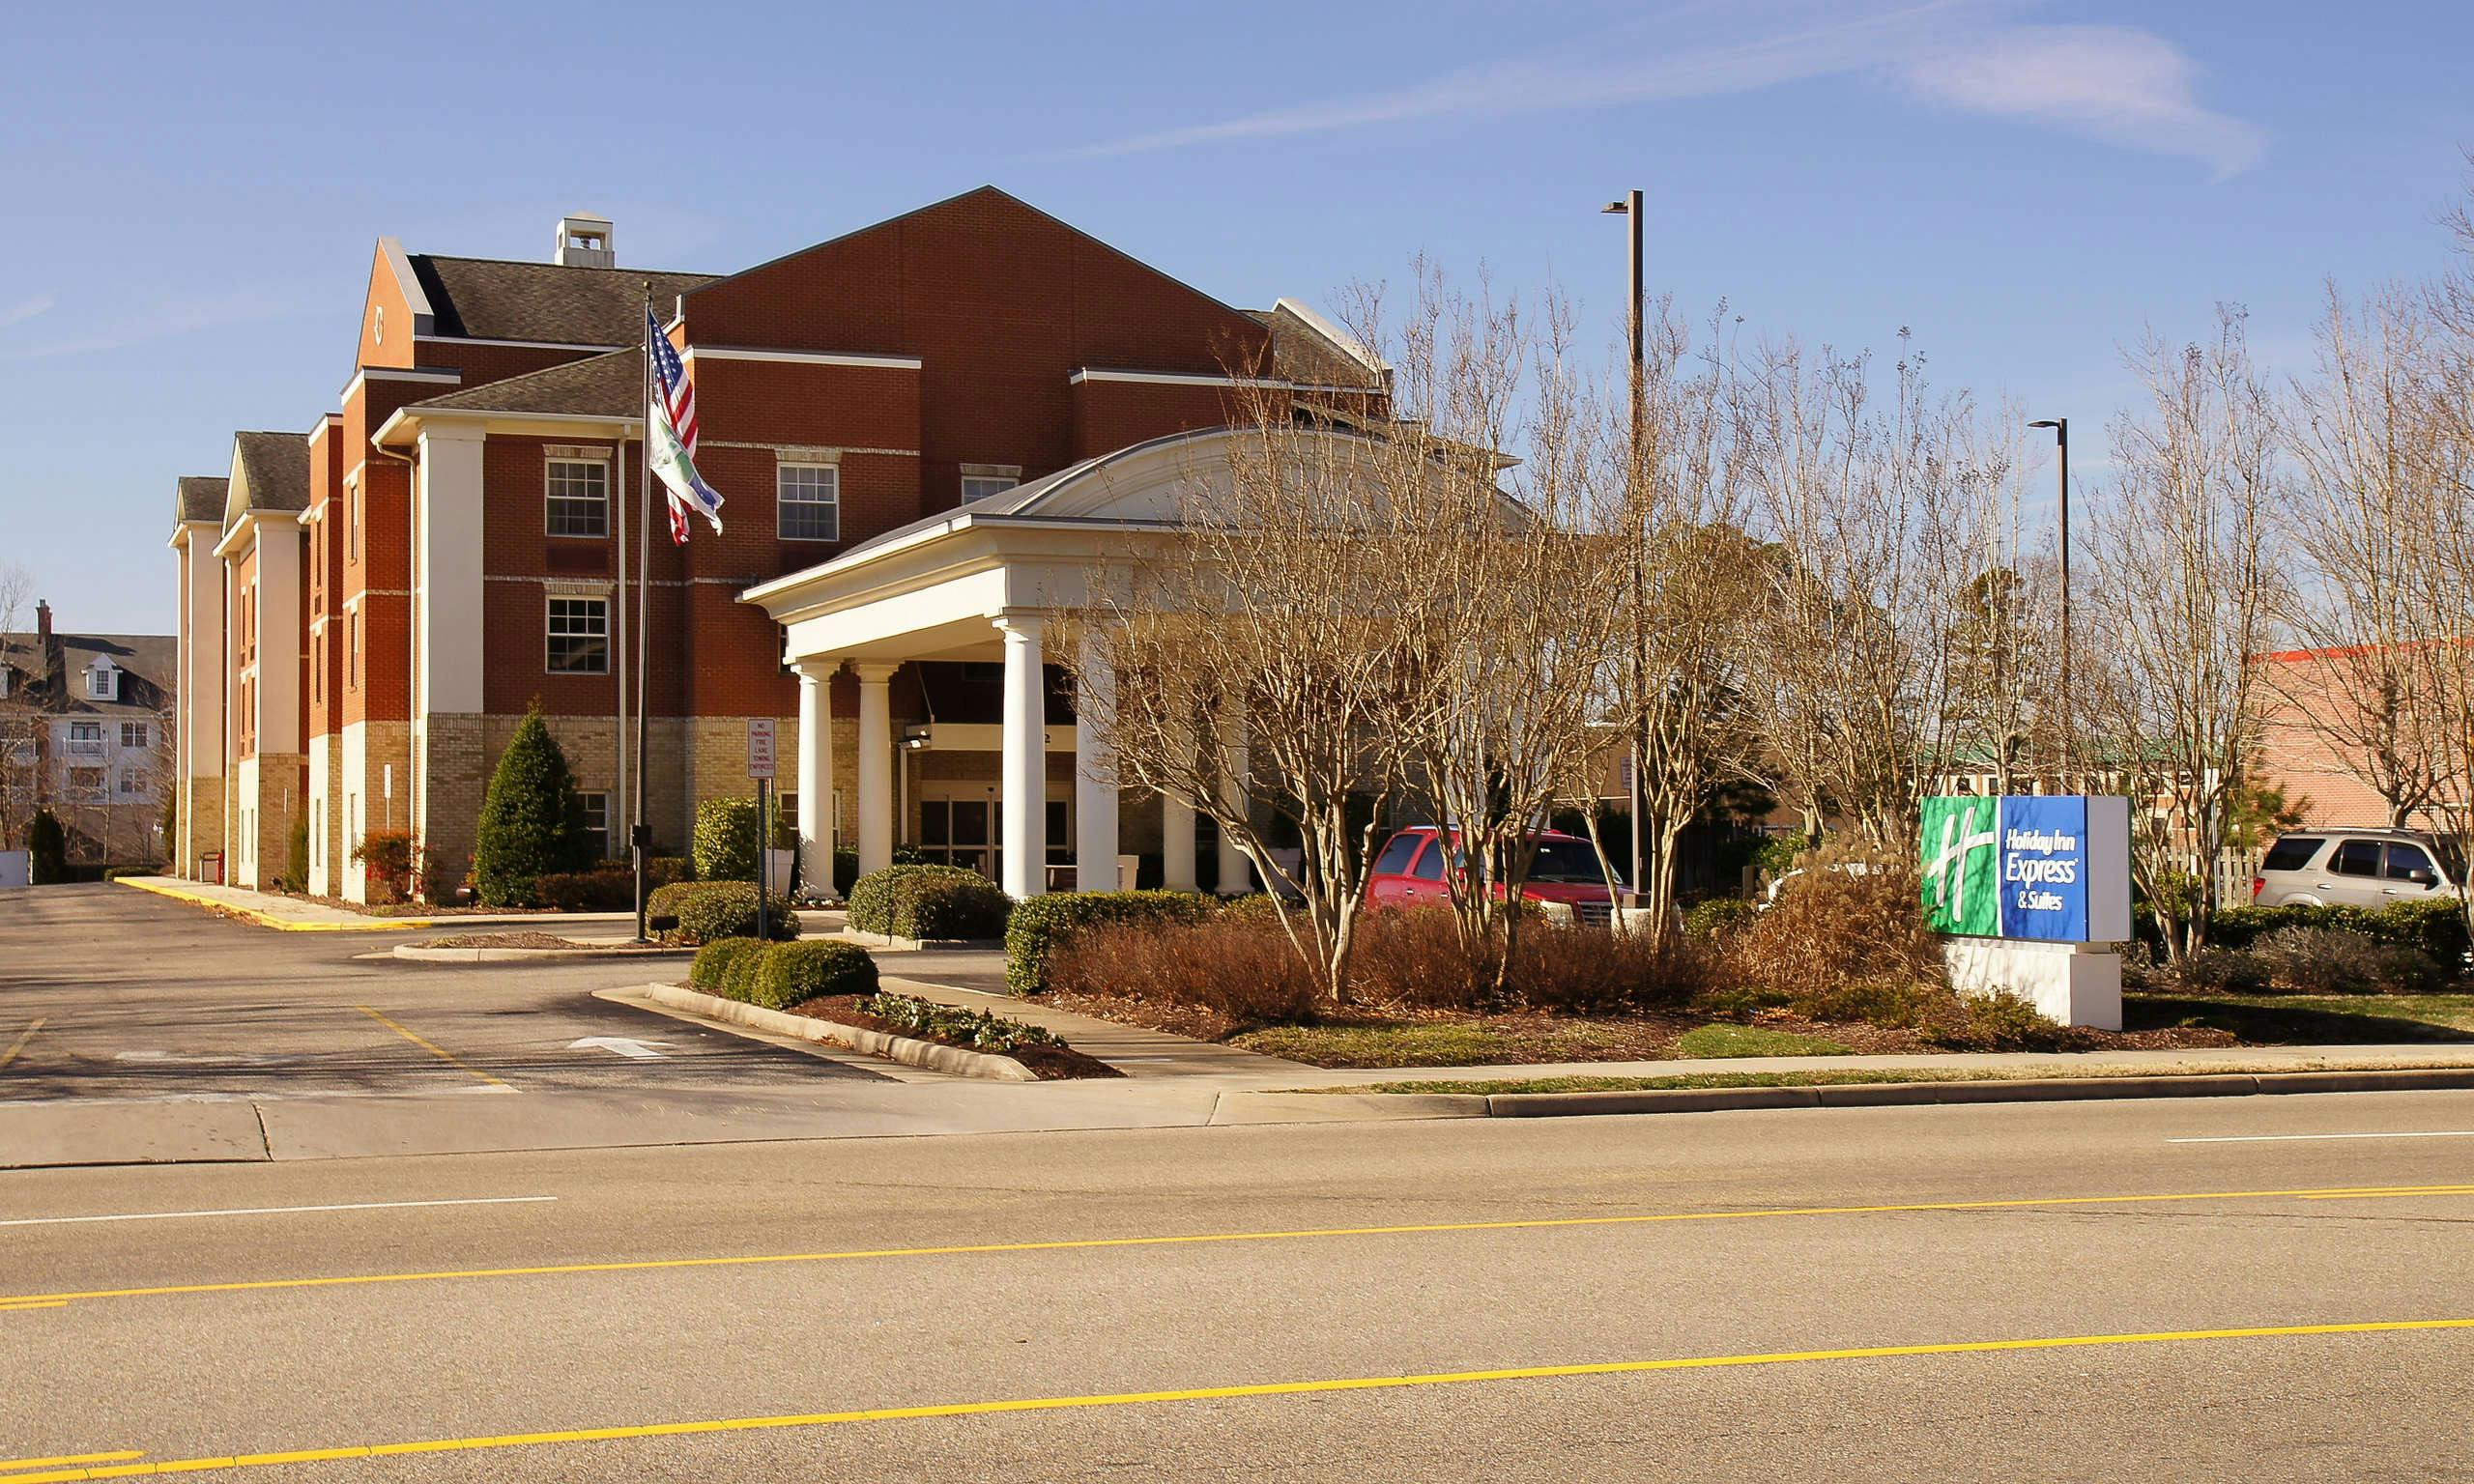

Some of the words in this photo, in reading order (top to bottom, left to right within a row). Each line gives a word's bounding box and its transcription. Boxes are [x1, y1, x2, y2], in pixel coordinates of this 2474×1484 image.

[2005, 828, 2053, 856] Holiday
[2054, 828, 2076, 851] Inn
[2005, 852, 2077, 890] Express
[2018, 891, 2027, 909] &
[2028, 891, 2063, 911] Suites
